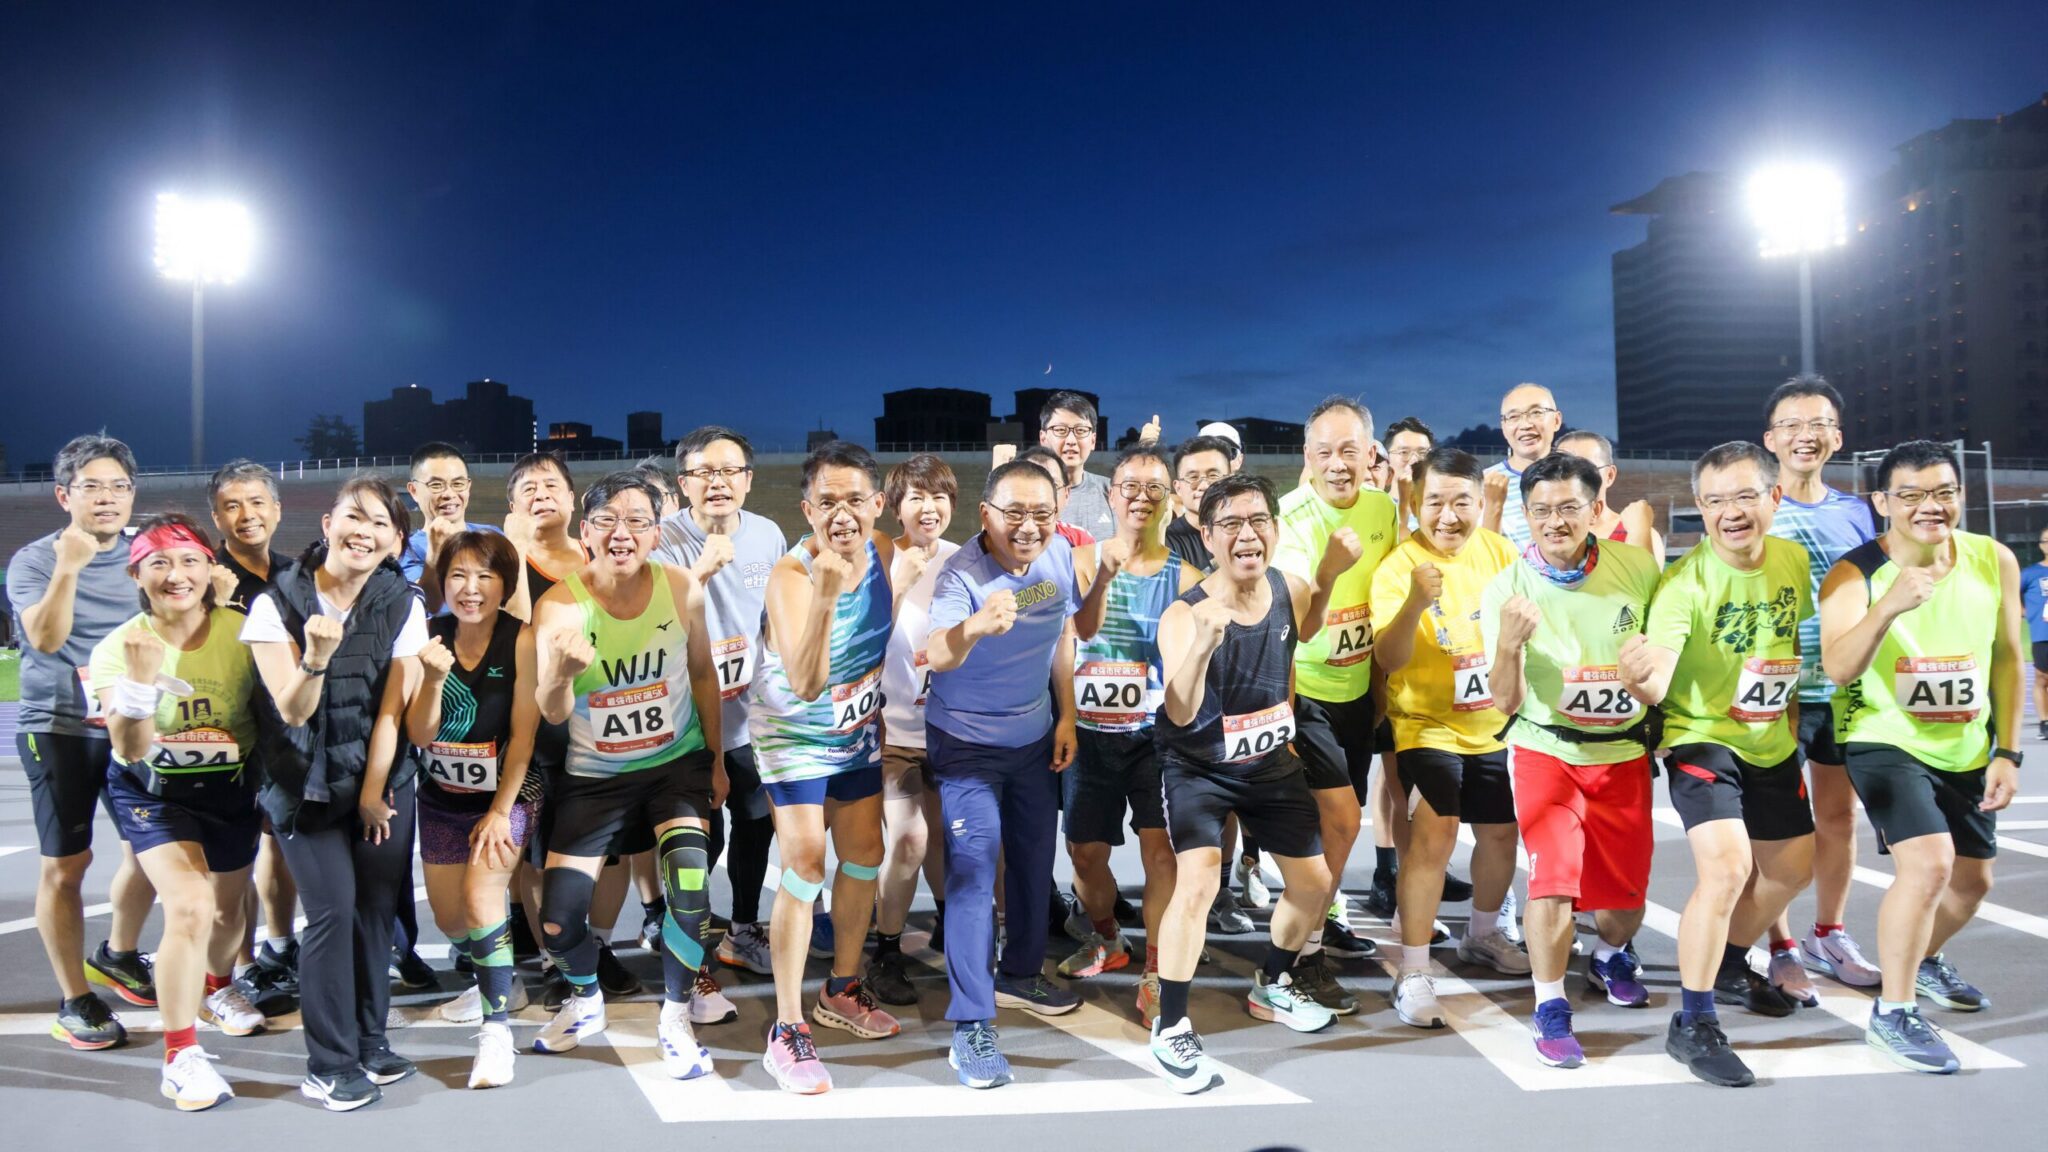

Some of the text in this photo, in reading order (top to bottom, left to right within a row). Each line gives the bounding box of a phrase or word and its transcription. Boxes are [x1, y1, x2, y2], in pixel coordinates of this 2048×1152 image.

[1080, 682, 1141, 708] A20
[1565, 688, 1633, 714] A28
[1907, 678, 1975, 706] A13
[602, 706, 664, 737] A18
[1229, 725, 1290, 760] A03
[152, 747, 228, 767] A24
[429, 759, 487, 785] A19
